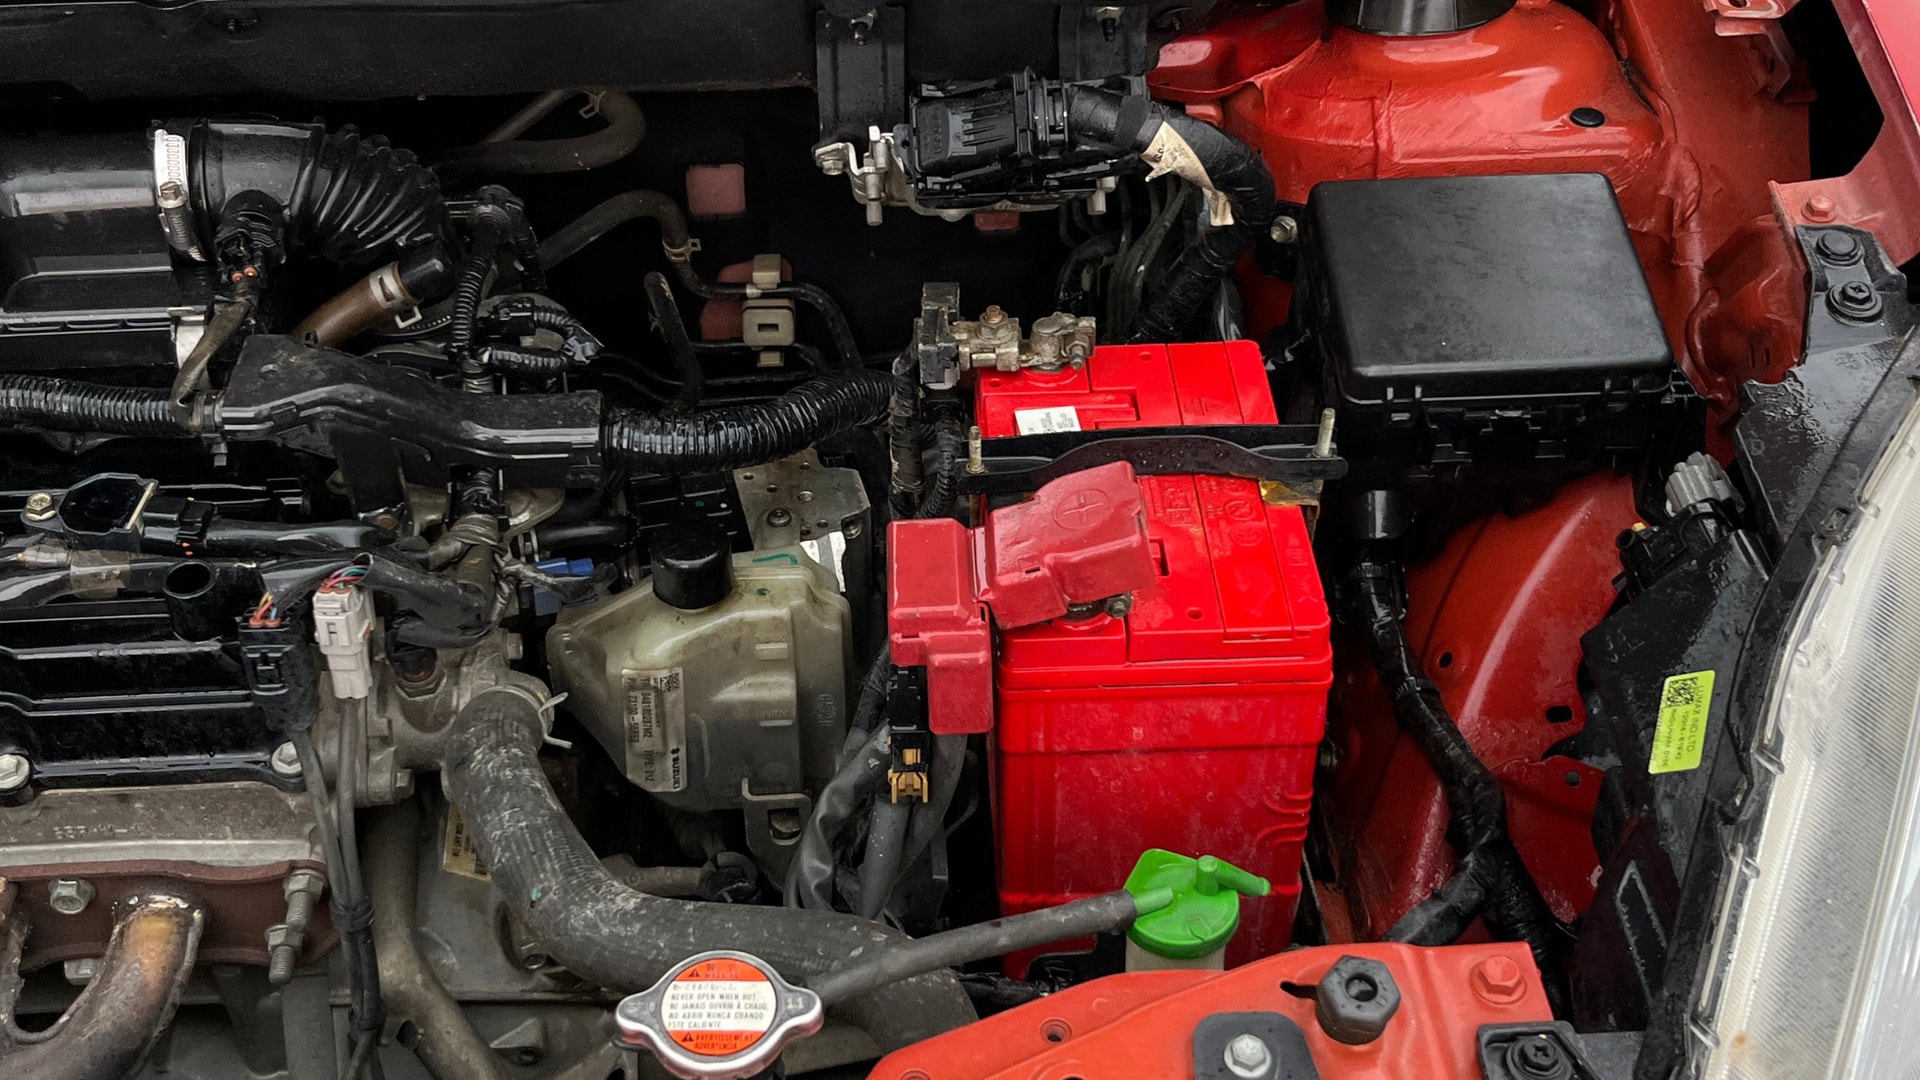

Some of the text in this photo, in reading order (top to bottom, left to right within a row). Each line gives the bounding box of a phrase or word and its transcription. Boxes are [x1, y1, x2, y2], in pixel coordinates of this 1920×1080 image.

[1693, 685, 1705, 715] LUMAX
[671, 755, 680, 789] SUZUKI
[671, 993, 694, 1001] NEVER
[697, 993, 716, 1001] OPEN
[719, 993, 739, 1001] WHEN
[695, 1033, 754, 1041] AVERTISSEMENT
[694, 1042, 738, 1050] ADVERTENCIA
